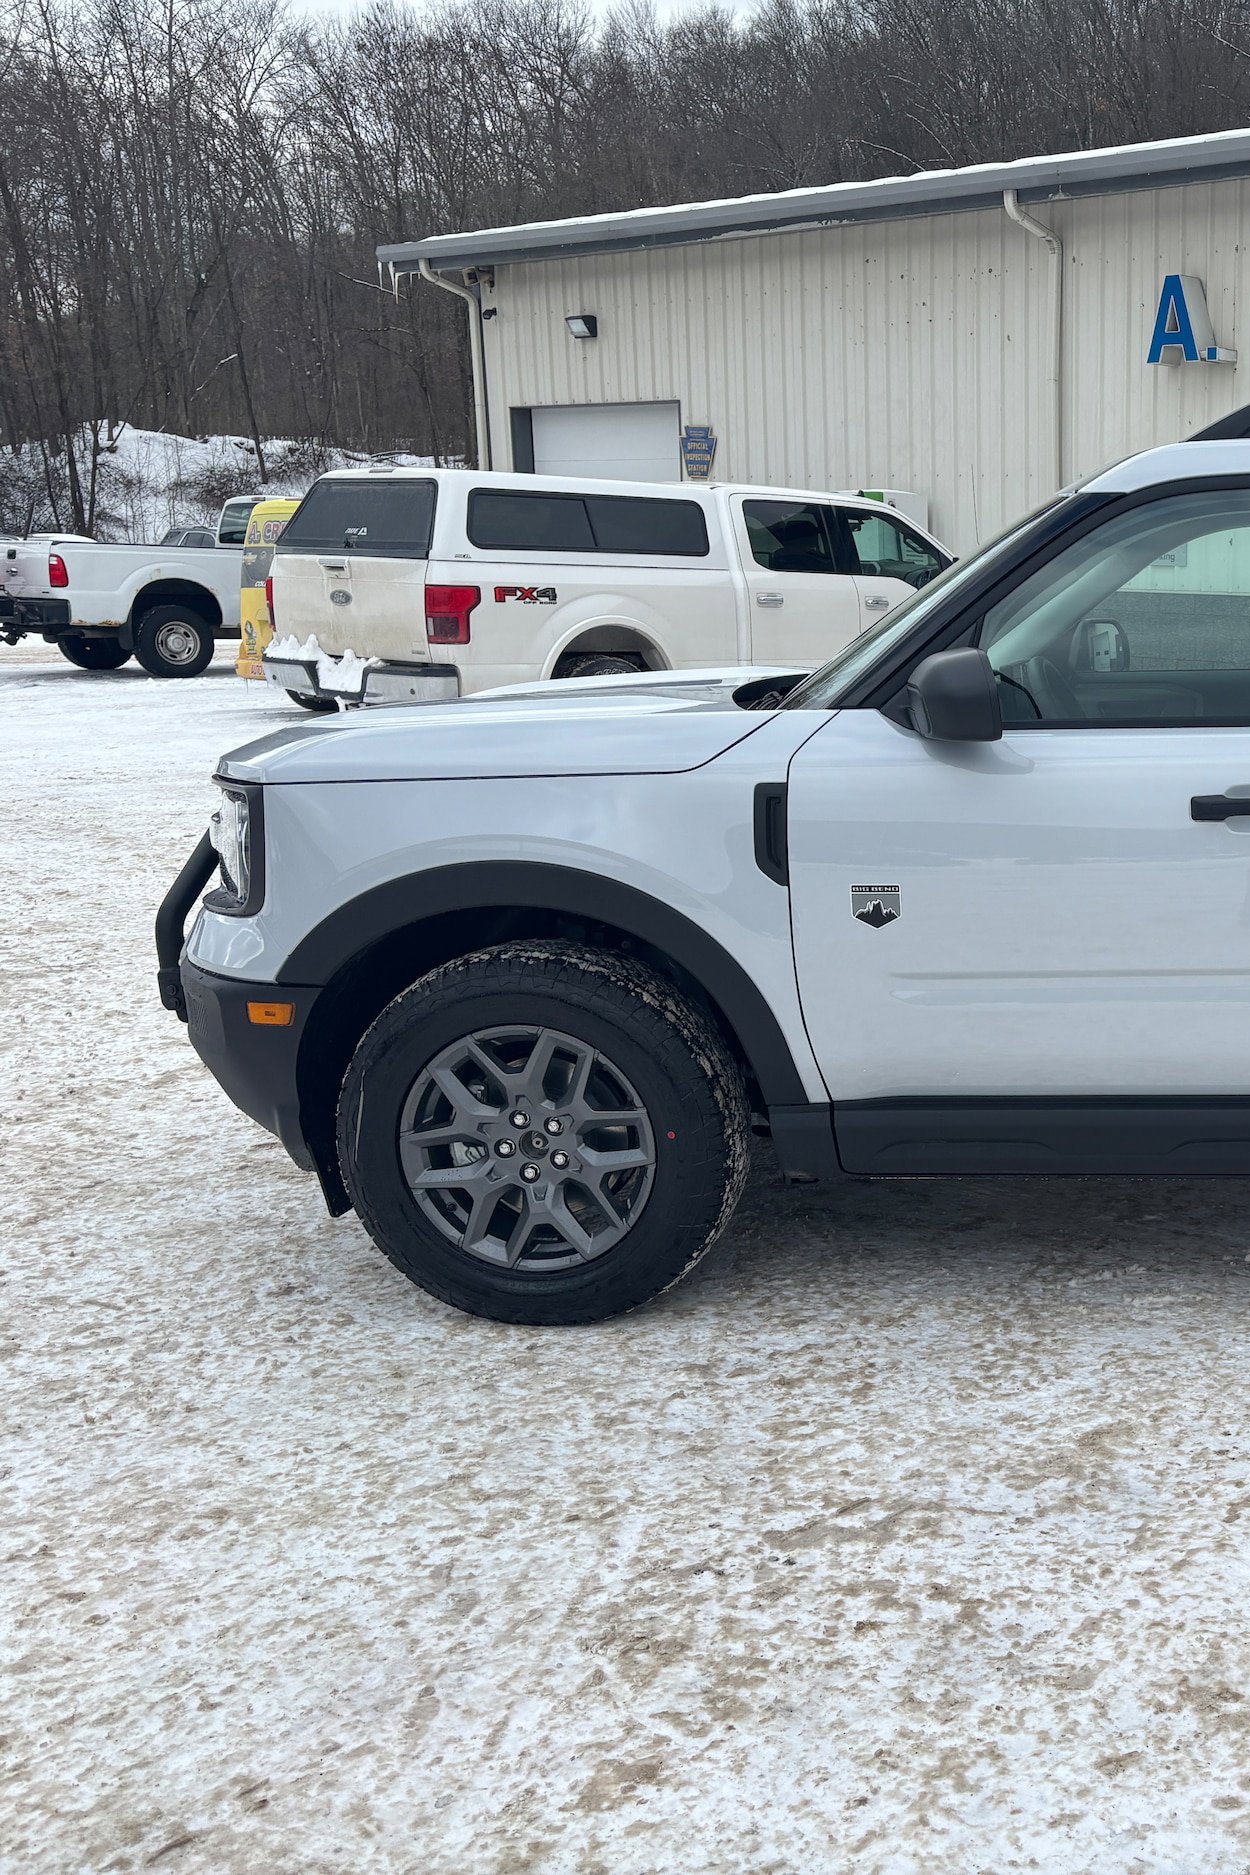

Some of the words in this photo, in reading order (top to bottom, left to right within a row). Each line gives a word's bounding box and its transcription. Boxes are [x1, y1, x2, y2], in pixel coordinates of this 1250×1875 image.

[1147, 274, 1220, 364] A.
[687, 442, 708, 450] OFFICIAL
[494, 586, 557, 602] FX4
